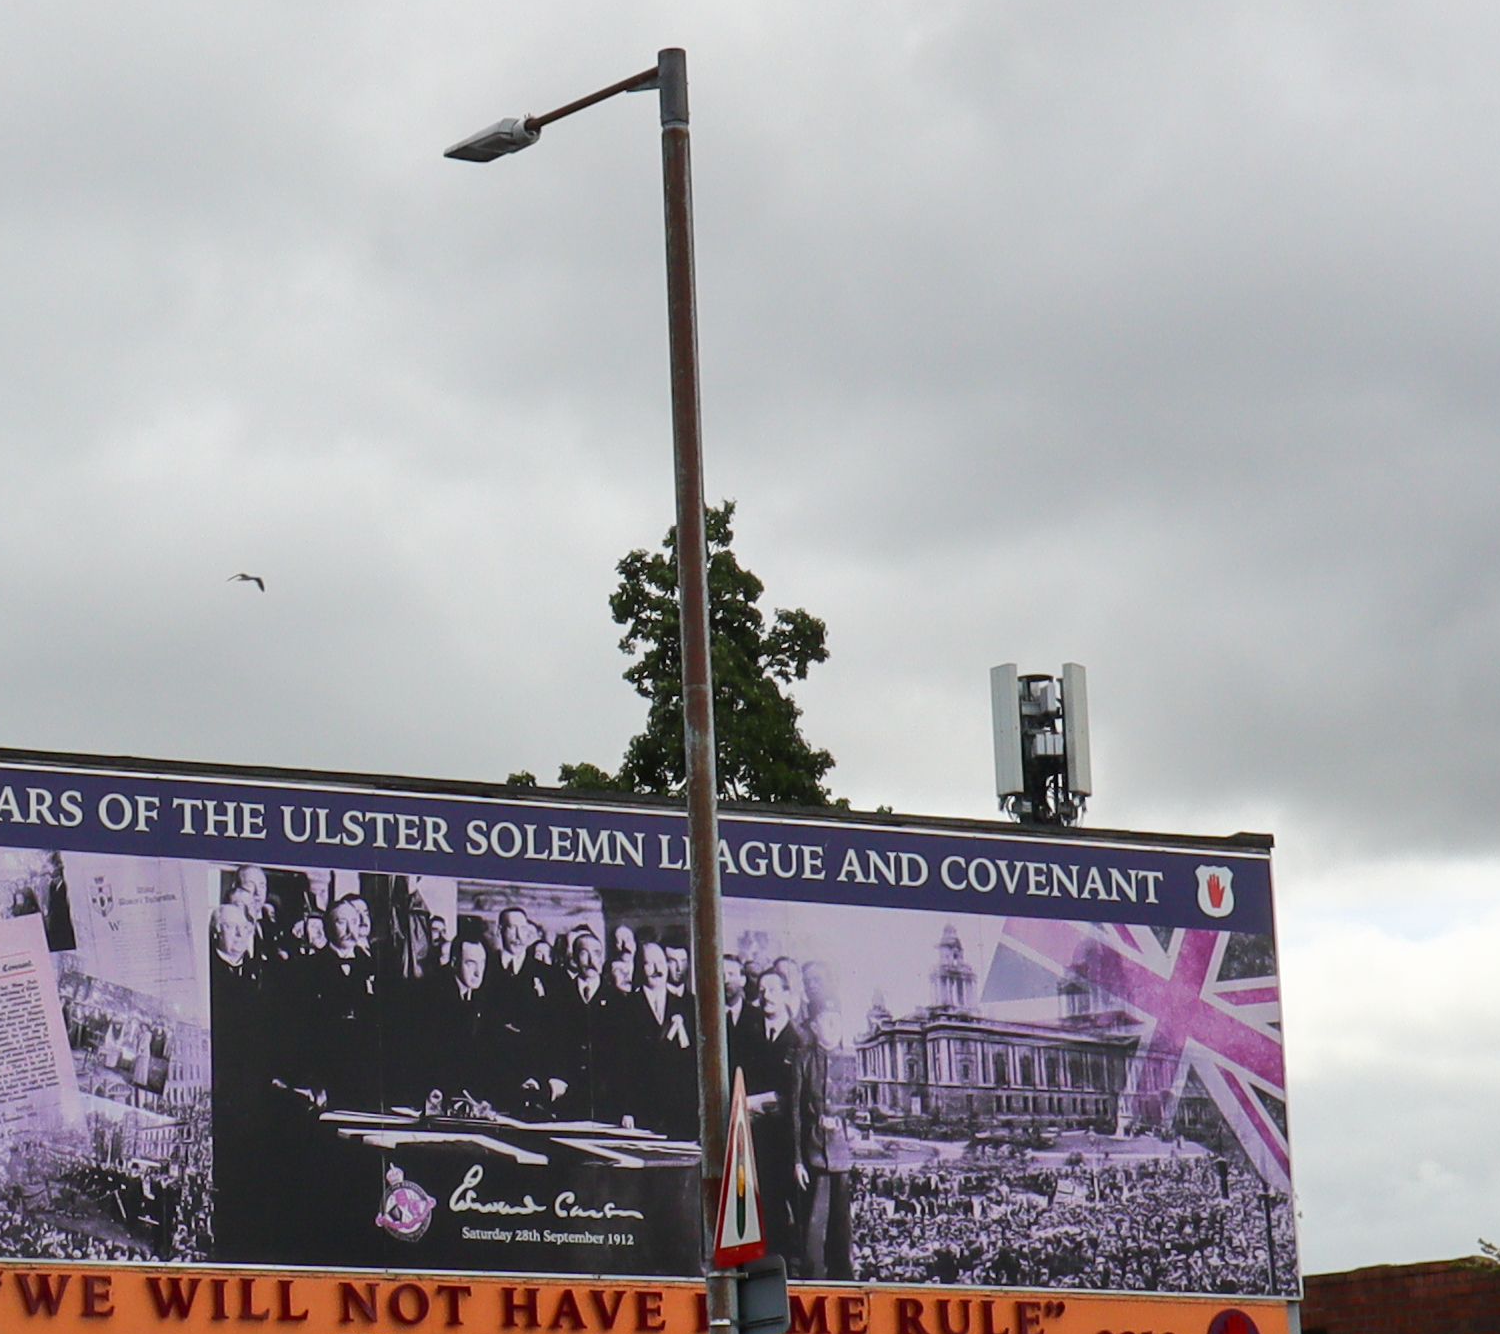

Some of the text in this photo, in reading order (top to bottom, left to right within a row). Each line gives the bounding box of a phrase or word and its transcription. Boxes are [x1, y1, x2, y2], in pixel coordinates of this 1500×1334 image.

[98, 791, 160, 832] OF
[172, 796, 268, 841] THE
[280, 805, 453, 855] ULSTER
[465, 818, 646, 869] SOLEMN
[836, 847, 929, 889] AND
[940, 854, 1164, 905] COVENANT
[462, 1226, 635, 1246] Saturday 28th September 1912
[145, 1275, 309, 1322] WILL
[338, 1281, 472, 1326] NOT
[501, 1286, 667, 1332] HAVE
